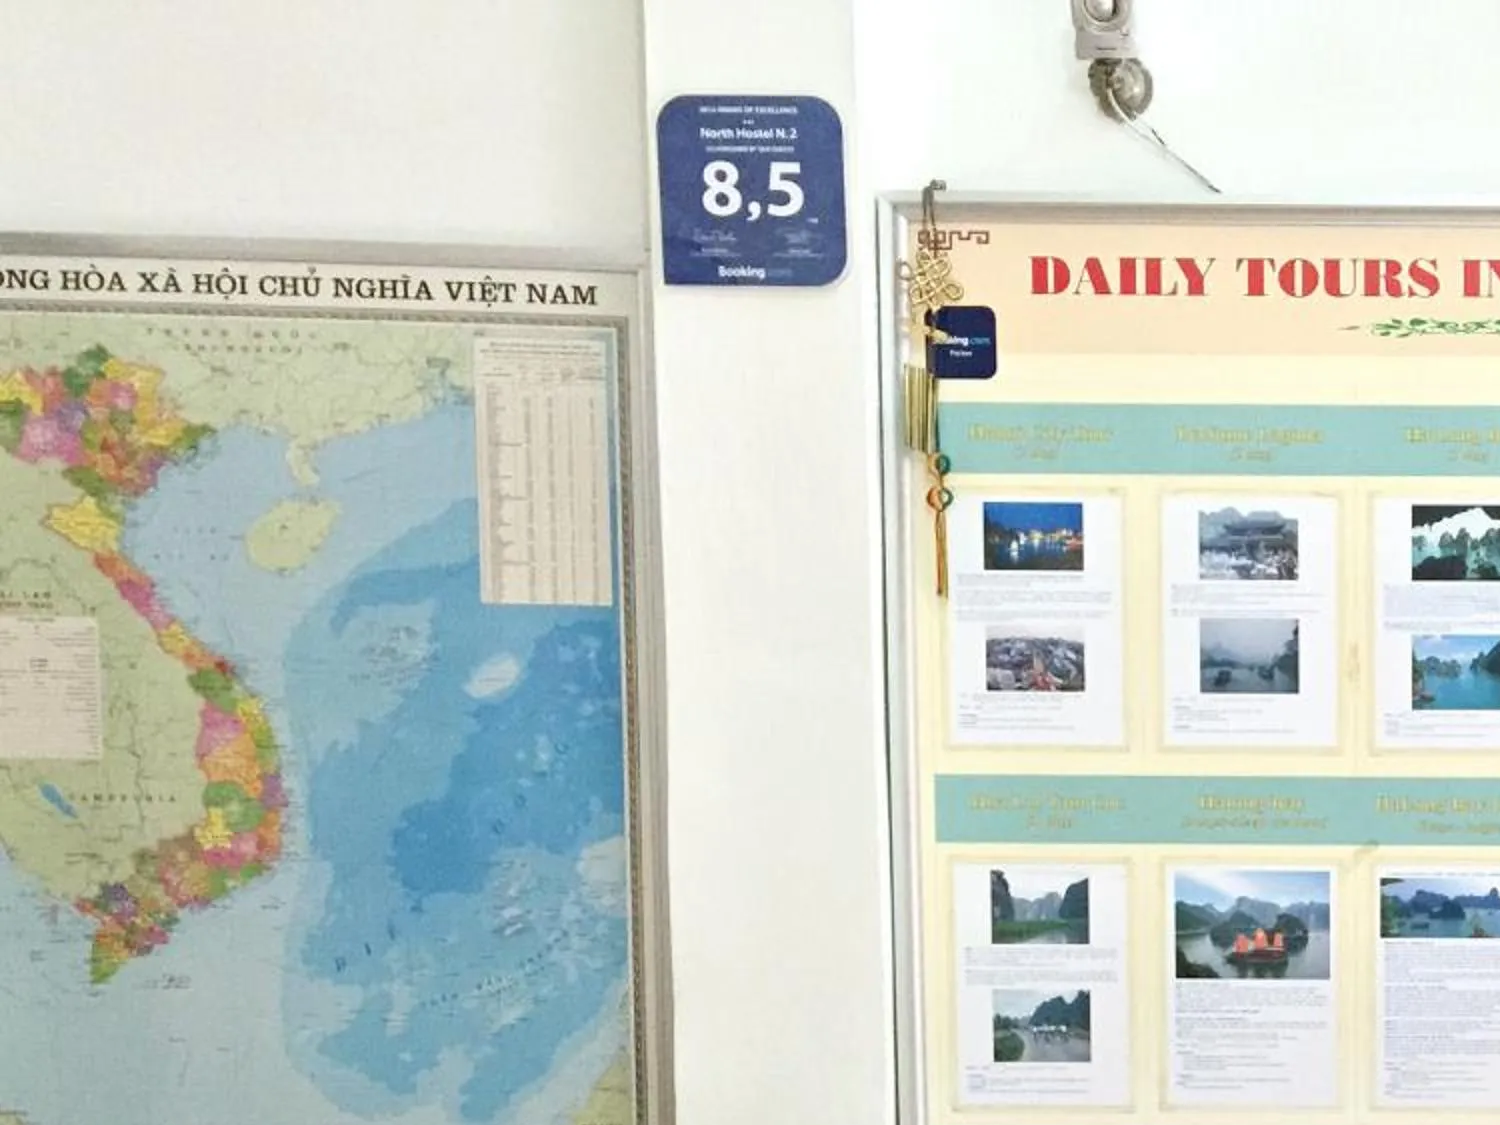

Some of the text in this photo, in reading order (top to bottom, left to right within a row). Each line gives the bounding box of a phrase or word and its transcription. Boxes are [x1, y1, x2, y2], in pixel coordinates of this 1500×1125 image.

[700, 127, 734, 139] North
[736, 127, 774, 139] Hostel
[702, 159, 805, 221] 8,5
[60, 265, 126, 291] HÒA
[527, 283, 598, 305] NAM
[1029, 256, 1216, 297] DAILY
[1236, 257, 1440, 299] TOURS
